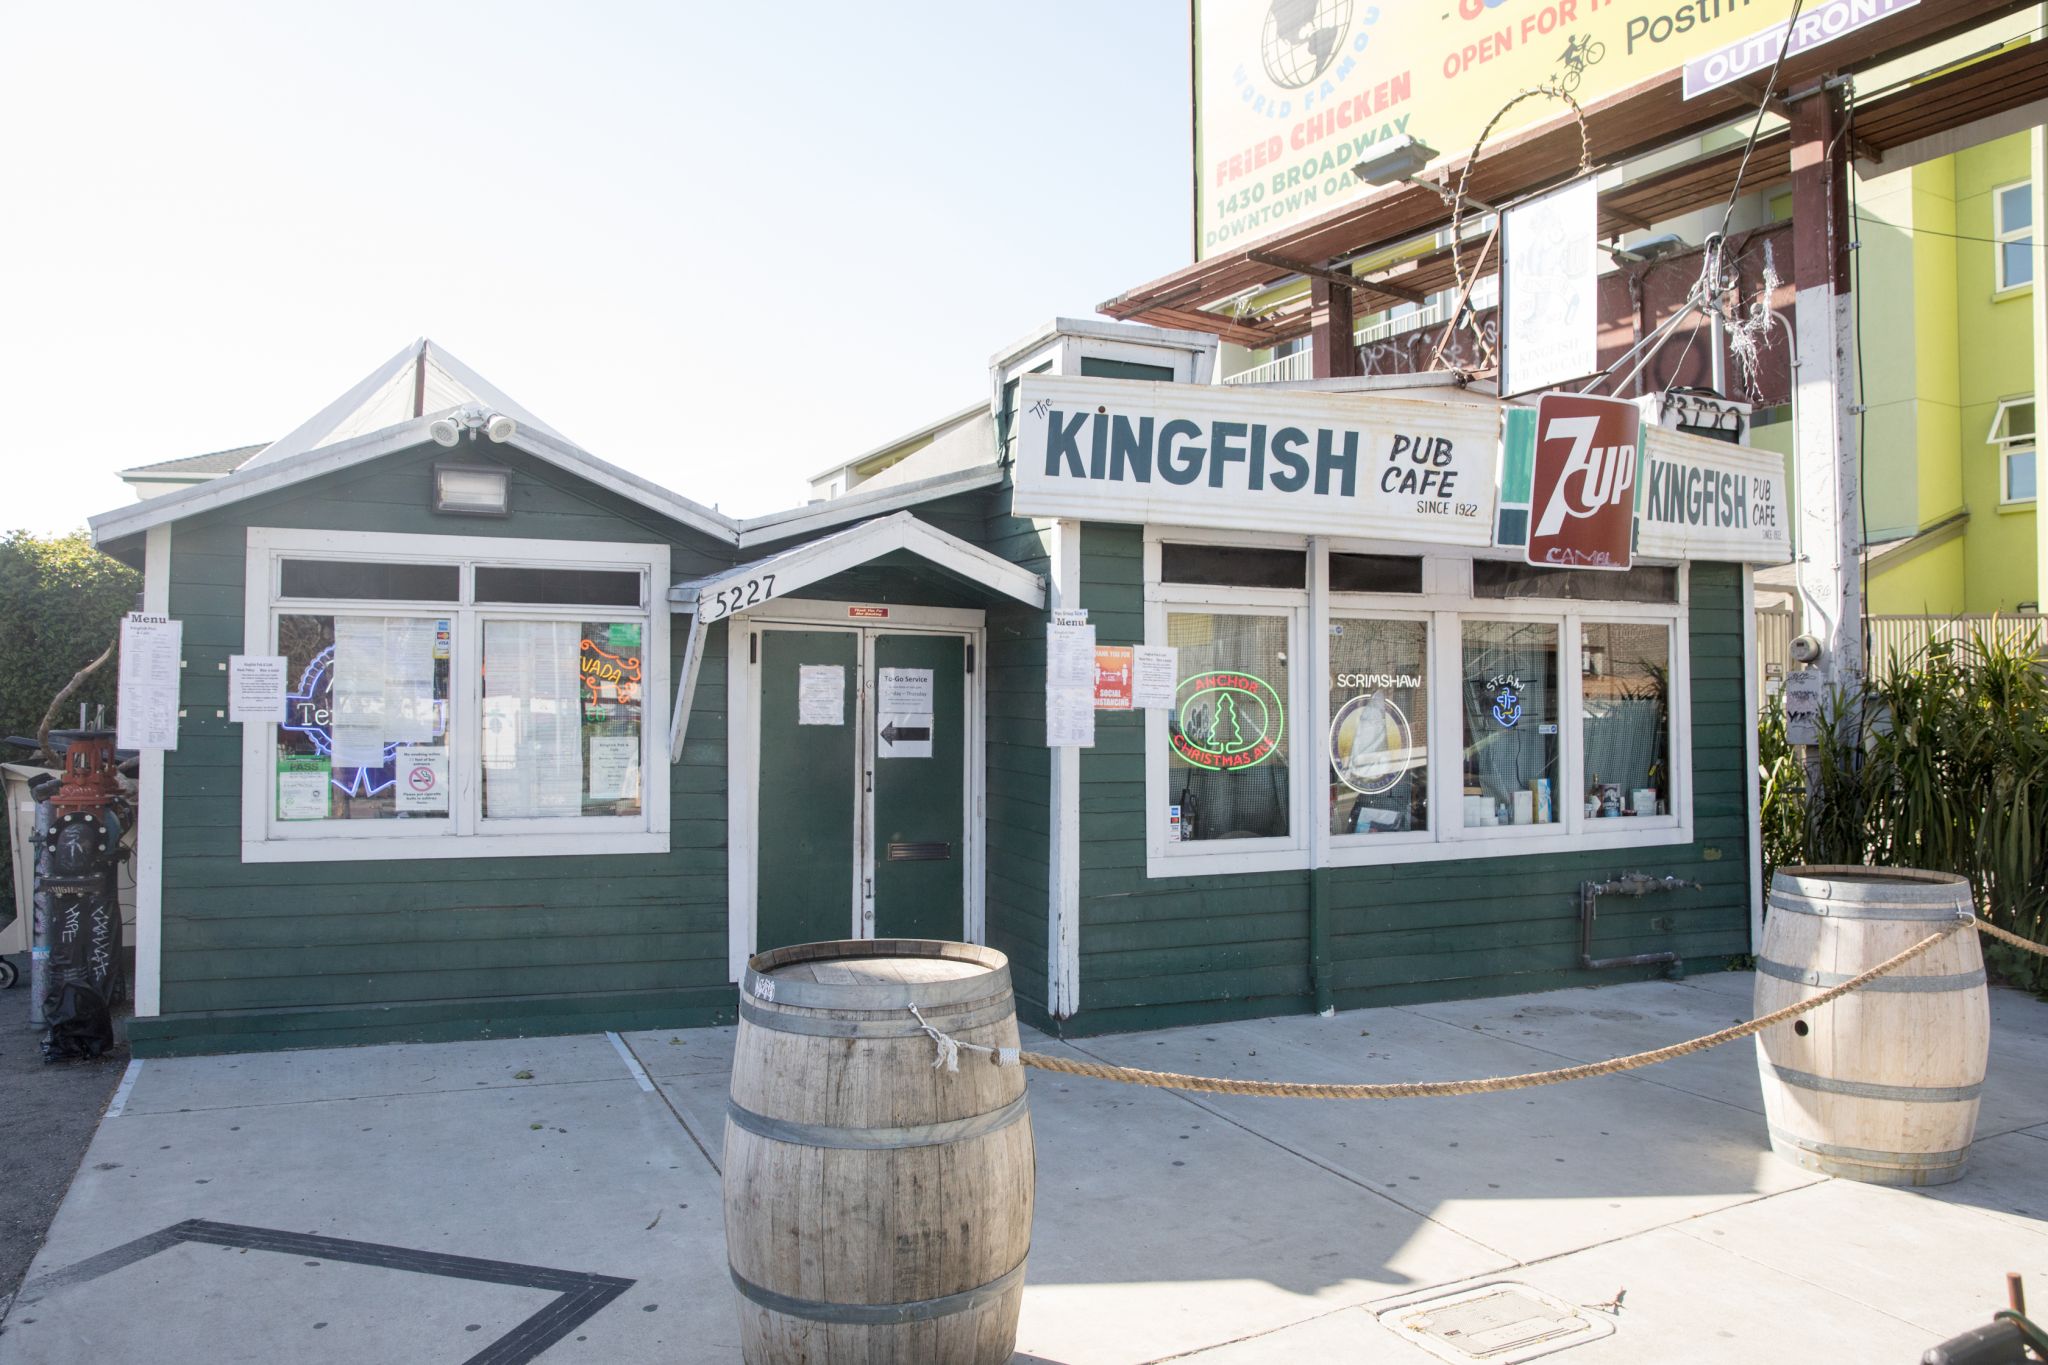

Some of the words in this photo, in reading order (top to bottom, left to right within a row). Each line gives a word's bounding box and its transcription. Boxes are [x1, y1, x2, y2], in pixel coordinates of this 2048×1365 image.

[1443, 26, 1513, 79] OPEN
[1521, 0, 1578, 44] FOR
[1703, 0, 1897, 84] OUTFRON
[1232, 63, 1292, 119] WORLD
[1303, 4, 1381, 111] FAMOU
[1215, 135, 1283, 188] FRIED
[1290, 70, 1411, 151] CHICKEN
[1217, 182, 1266, 219] 1430
[1272, 113, 1411, 195] BROADWAY
[1206, 184, 1318, 248] DOWNTOWN
[1029, 397, 1053, 421] The
[1045, 411, 1359, 497] KINGFISH
[1389, 434, 1454, 467] PUB
[1381, 467, 1458, 499] CAFE
[1647, 460, 1748, 529] KINGFISH
[1752, 477, 1771, 501] PUB
[1417, 500, 1449, 515] SINCE
[1455, 502, 1478, 517] 1922
[1752, 503, 1776, 527] CAFE
[715, 574, 776, 618] 5227
[131, 614, 167, 624] Menu
[1056, 617, 1085, 627] Menu
[580, 655, 622, 684] VADA
[904, 675, 928, 683] Service
[1195, 675, 1259, 693] ANCHOR
[1337, 673, 1421, 688] SCRIMSHAW
[1486, 674, 1525, 694] STEAM
[1174, 734, 1251, 766] CHRISTMAS
[1253, 736, 1273, 760] ALE
[289, 763, 319, 772] PASS
